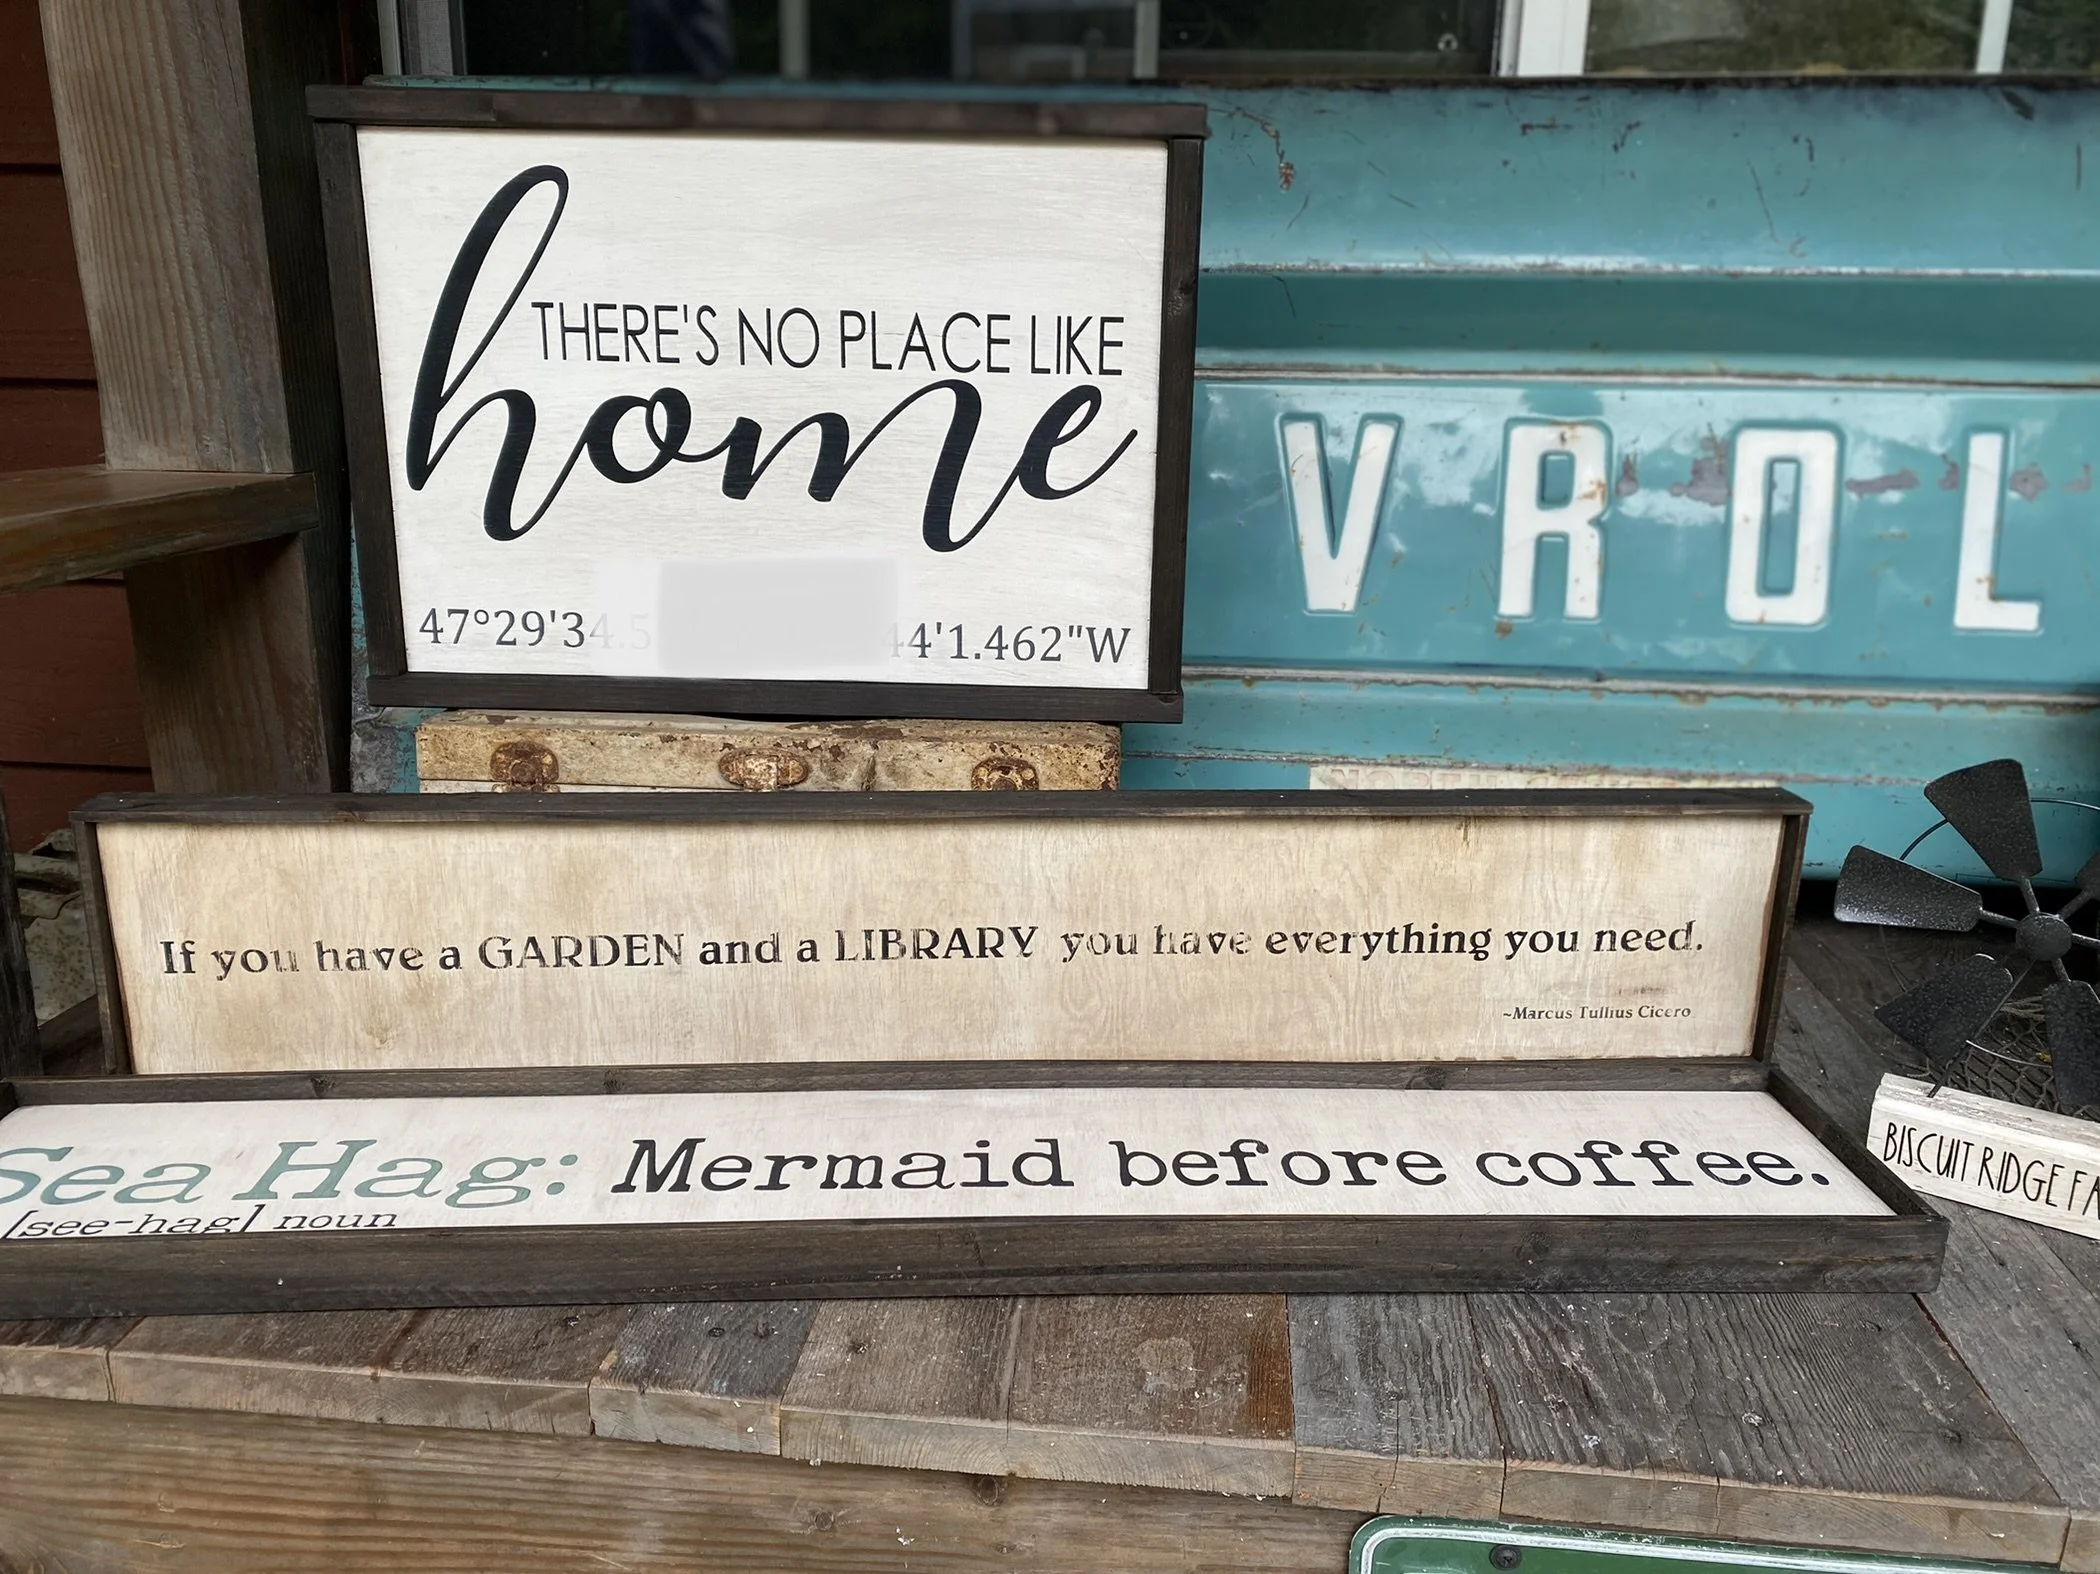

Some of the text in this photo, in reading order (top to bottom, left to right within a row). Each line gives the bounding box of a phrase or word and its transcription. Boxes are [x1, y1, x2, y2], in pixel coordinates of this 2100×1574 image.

[406, 164, 1138, 553] home
[531, 301, 1124, 376] THERE'S NO PLACE LIKE
[1279, 415, 2043, 634] VROL
[160, 919, 1703, 981] If you have a GARDEN and a LIBRARY you have everything you need.
[1579, 1005, 1633, 1020] Tullius
[1638, 1004, 1692, 1019] Cicero
[0, 1138, 1831, 1209] Sea Hag: Mermaid before coffee.
[1883, 1121, 1975, 1183] BISCUIT
[1977, 1146, 2065, 1208] RIDGE
[1, 1204, 398, 1240] [see-hag] noun
